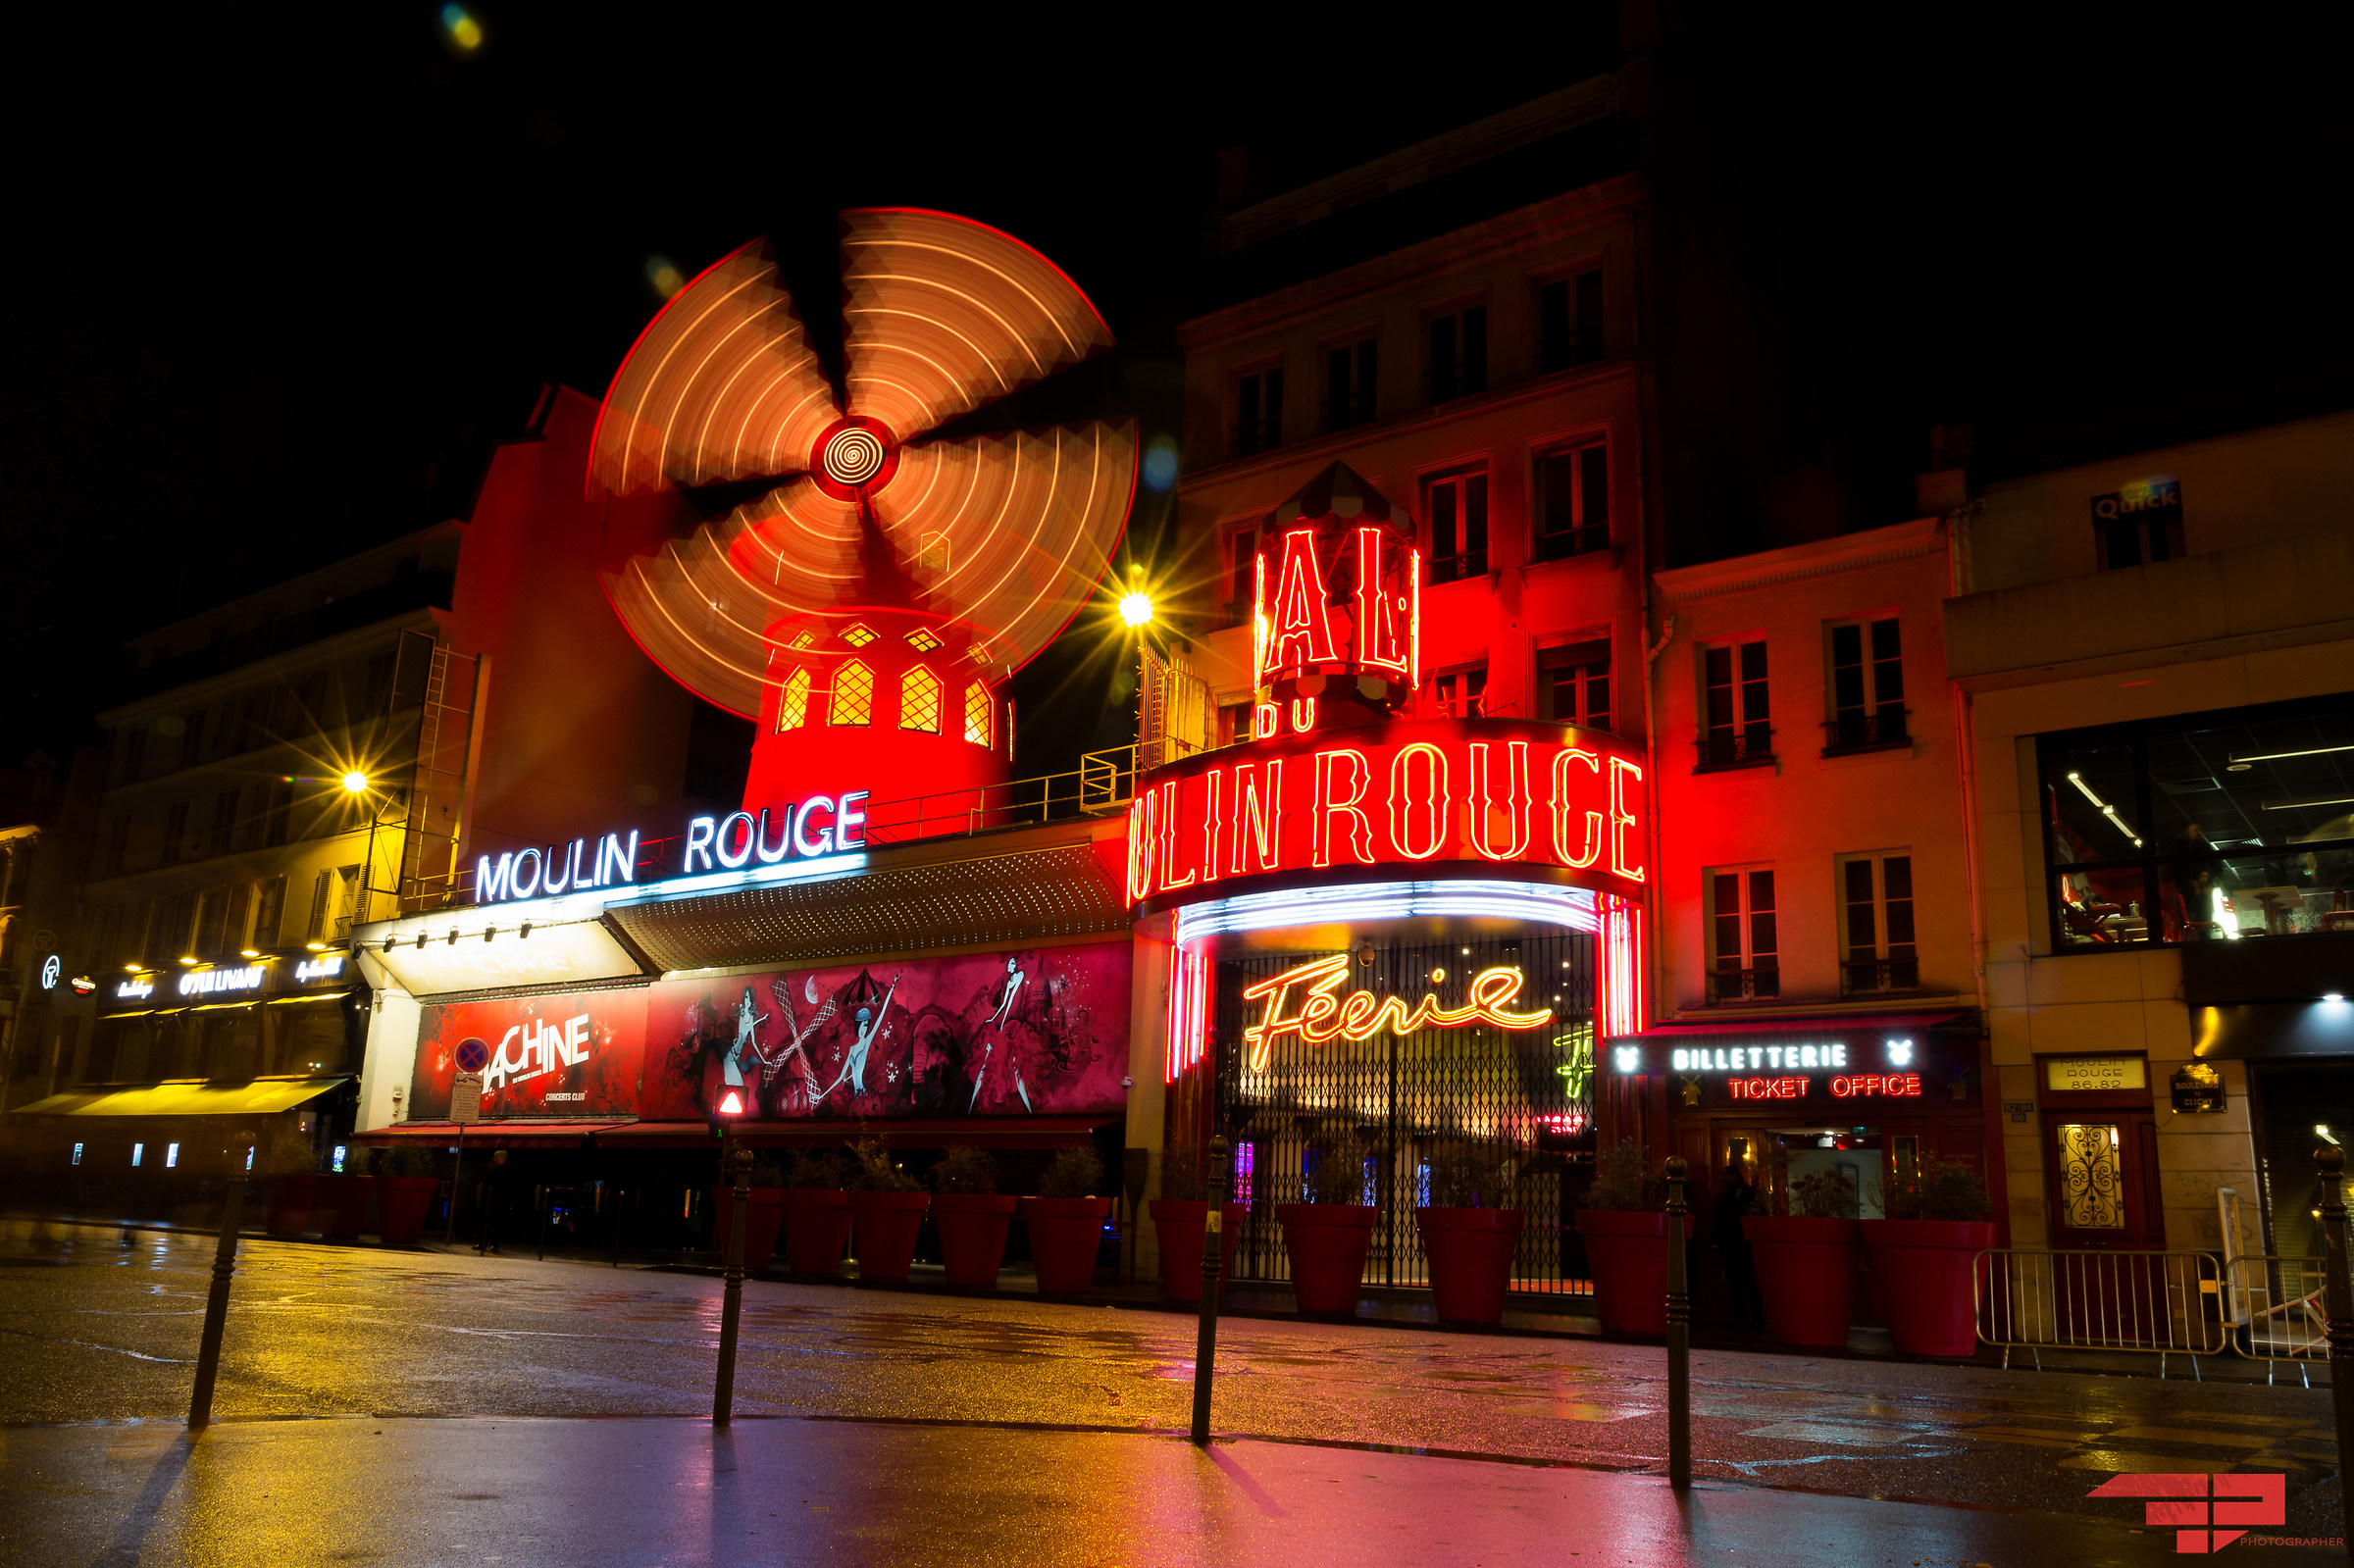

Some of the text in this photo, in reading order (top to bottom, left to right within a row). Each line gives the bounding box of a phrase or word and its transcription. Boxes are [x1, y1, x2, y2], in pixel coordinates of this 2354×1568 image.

[2095, 486, 2177, 520] Quick
[1254, 528, 1409, 693] AL
[1256, 697, 1315, 739] DU
[1126, 741, 1645, 908] ULIN ROUGE
[476, 789, 871, 904] MOULIN ROUGE
[1673, 1044, 1847, 1071] BILLETTERIE
[2060, 1058, 2126, 1067] MOULIN
[2067, 1068, 2124, 1078] ROUGE
[2072, 1080, 2122, 1089] 86.82
[545, 1092, 586, 1101] CONCERTS CLUB
[1728, 1075, 1921, 1099] TICKET OFFICE
[2175, 1082, 2220, 1090] BOULEVARD
[2183, 1097, 2214, 1106] CLICHY
